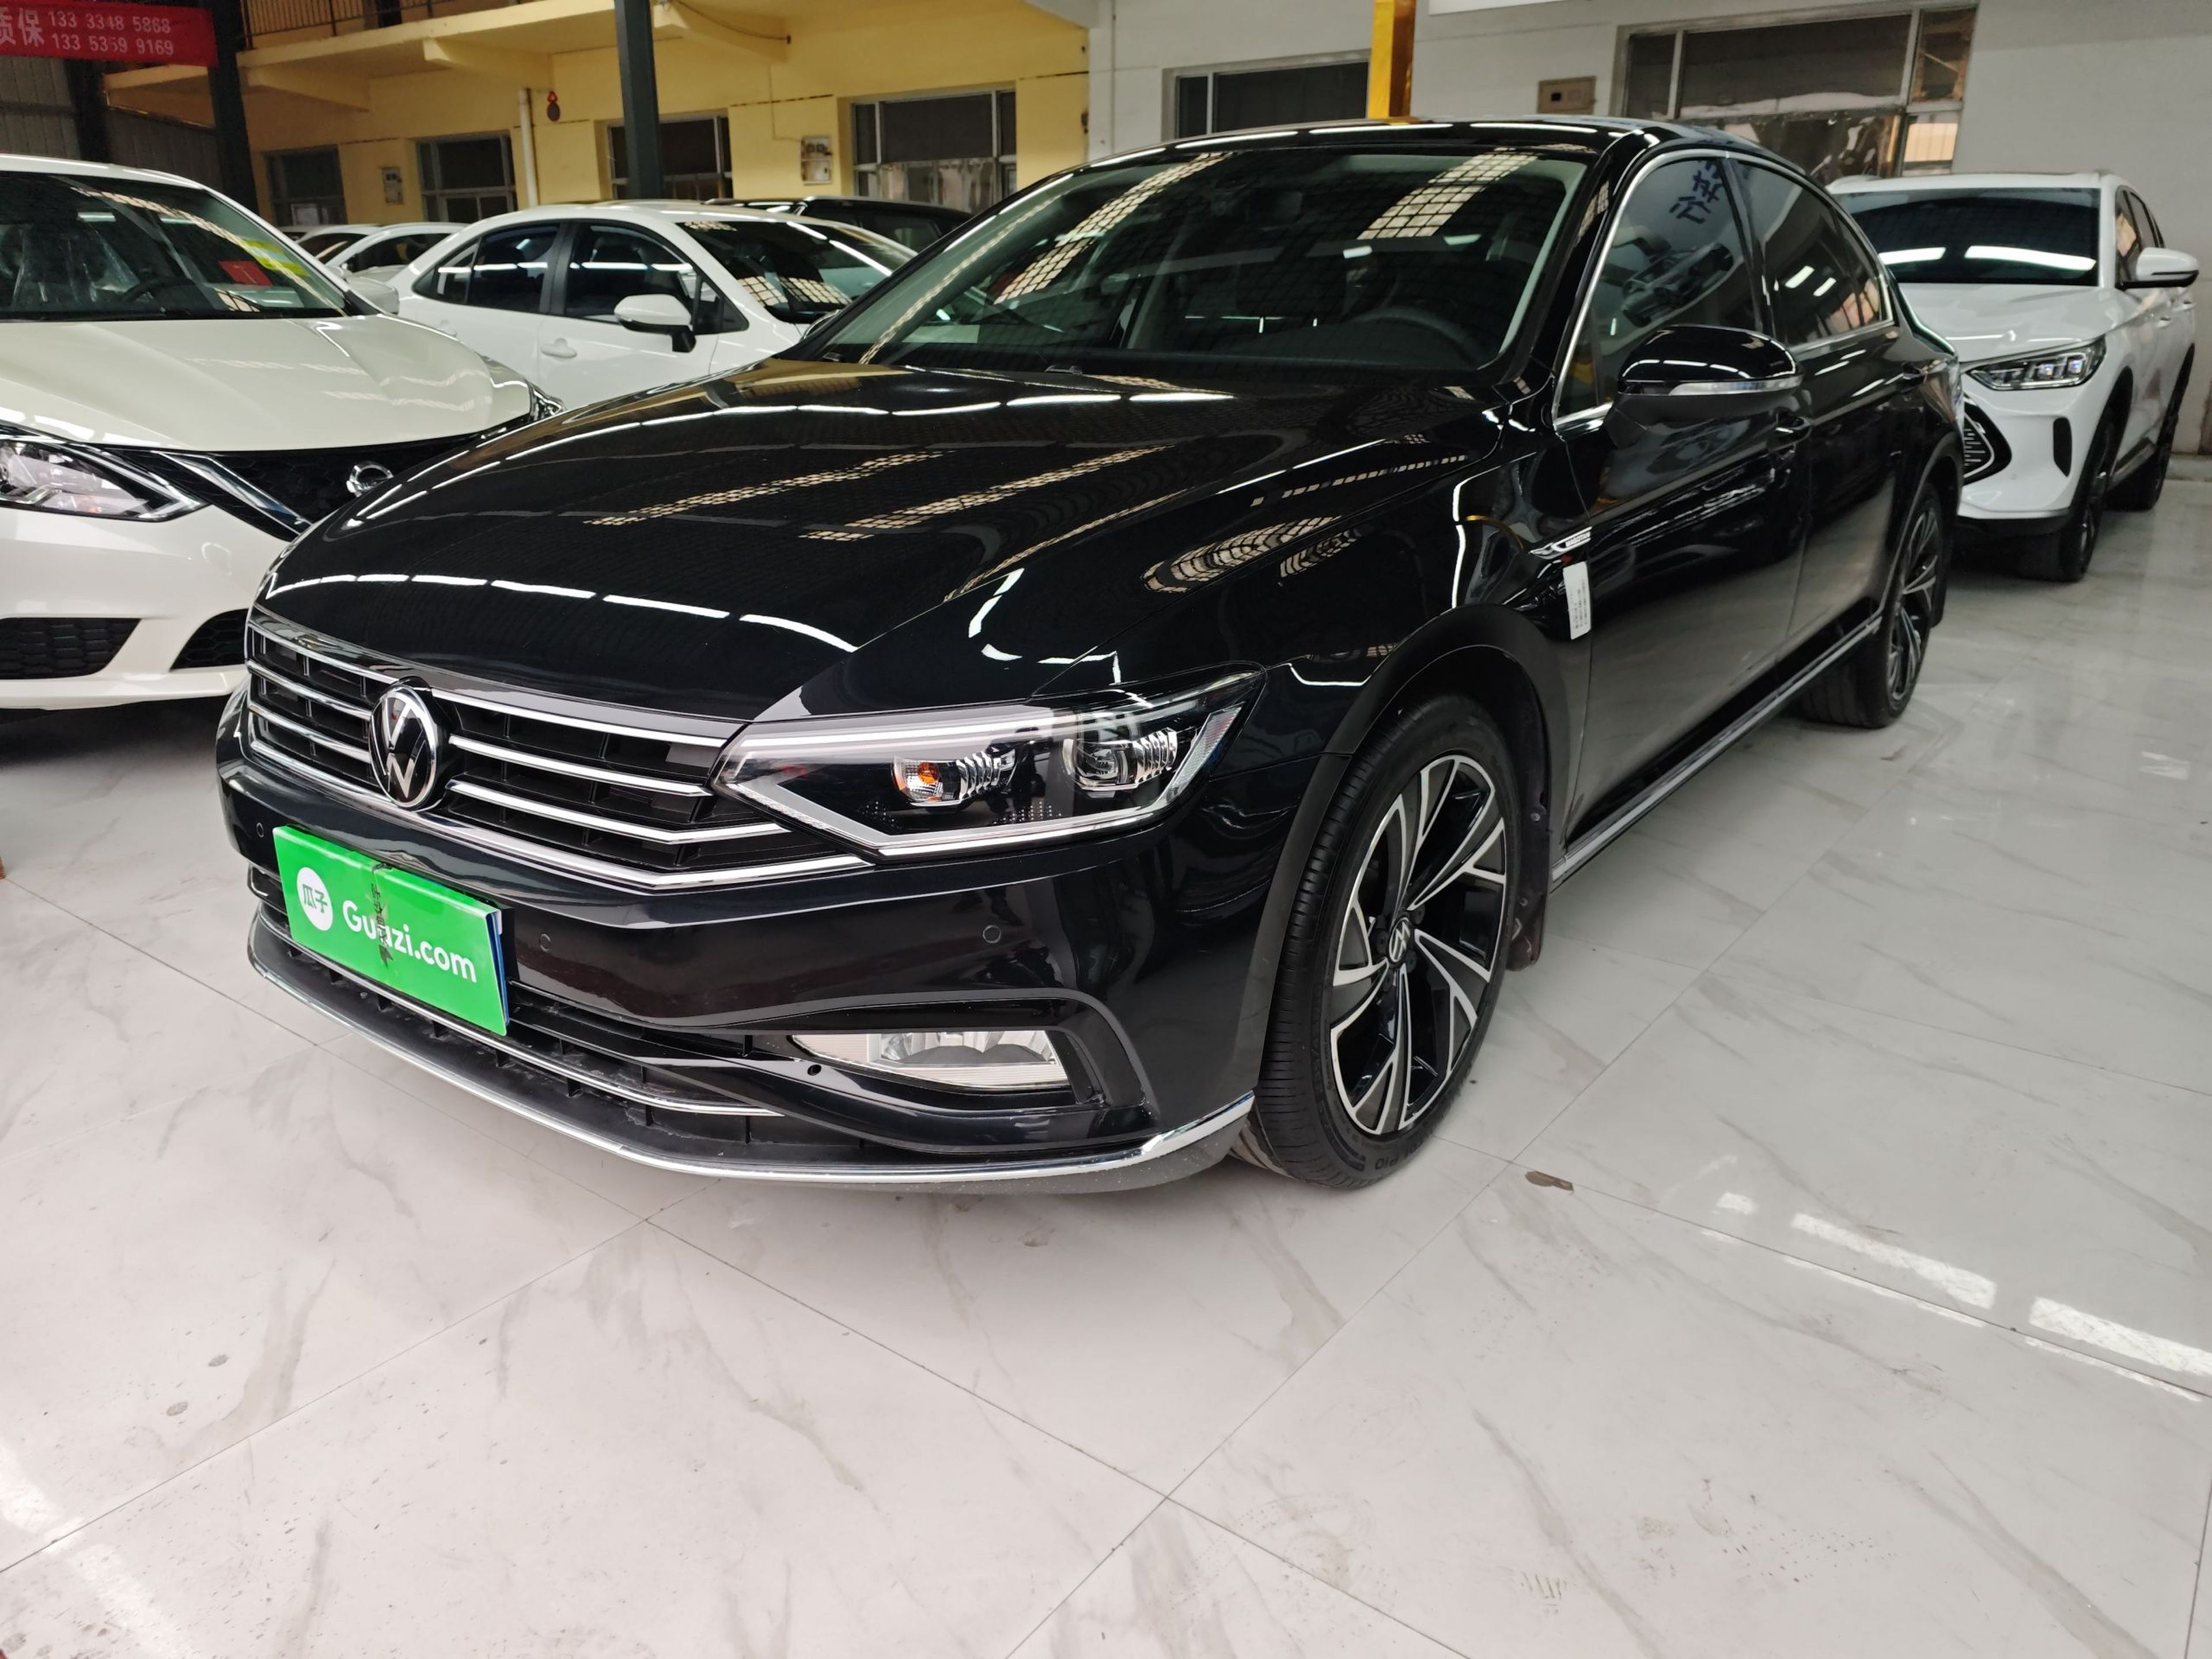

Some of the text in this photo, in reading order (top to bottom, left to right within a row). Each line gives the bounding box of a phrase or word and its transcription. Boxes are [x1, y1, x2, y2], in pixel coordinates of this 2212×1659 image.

[48, 10, 172, 34] 133 3348 5868
[52, 33, 173, 56] 133 5359 9169
[302, 883, 329, 914] 瓜子
[343, 900, 477, 983] Guazi.com
